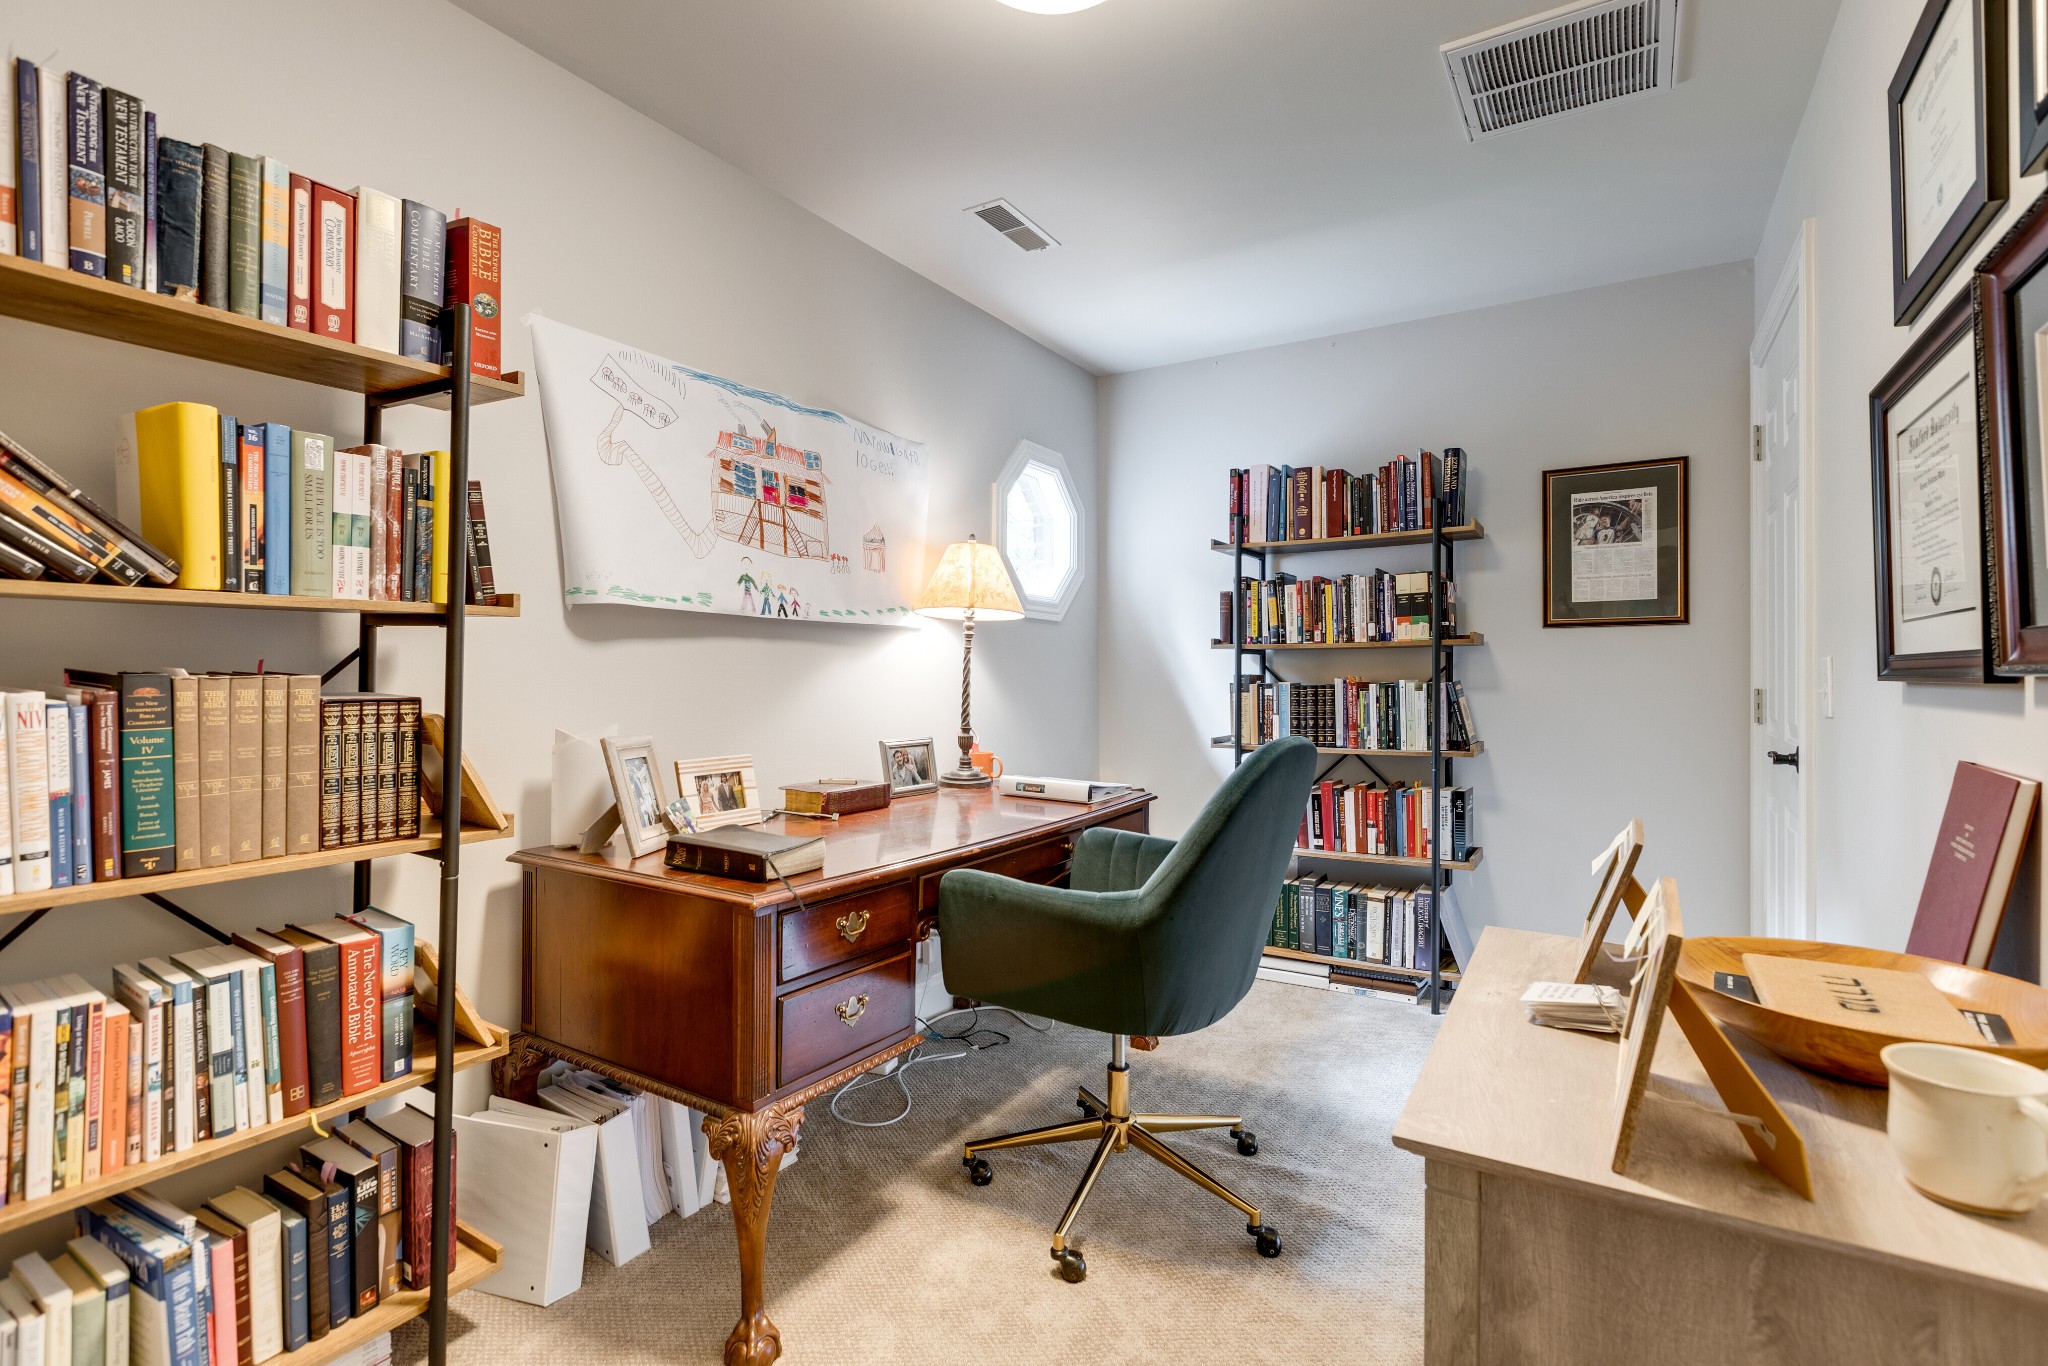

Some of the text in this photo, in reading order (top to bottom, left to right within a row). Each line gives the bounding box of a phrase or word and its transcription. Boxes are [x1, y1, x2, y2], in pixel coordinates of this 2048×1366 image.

[76, 77, 90, 165] NEW TESTAMENT
[115, 96, 128, 185] NEW TESTAMENT
[115, 224, 125, 243] MOO
[125, 219, 137, 248] CARSON
[325, 218, 336, 270] COMMENTARY
[410, 210, 422, 290] COMMENTARY
[83, 261, 94, 271] B
[423, 238, 432, 271] BIBLE
[478, 228, 492, 281] BIBLE
[247, 433, 258, 442] 16
[1444, 456, 1452, 493] NEHEMIAH
[1451, 475, 1459, 490] AND
[304, 473, 314, 540] SMALL FOR US
[316, 476, 325, 560] THE PLACE IS TOO
[17, 711, 43, 730] NIV
[74, 712, 84, 755] Philippians
[58, 714, 66, 779] COLOSSIANS
[129, 735, 165, 745] Volume
[141, 746, 154, 755] IV
[103, 769, 112, 790] JAMES
[363, 945, 376, 969] The
[391, 944, 399, 977] WORD
[400, 948, 408, 968] KEY
[348, 950, 361, 1045] Annotated Bible
[363, 970, 376, 997] New
[151, 1014, 159, 1056] MISSIONAL
[195, 999, 204, 1063] THE GREAT EMERGENCE
[363, 999, 377, 1041] Oxford
[92, 1026, 102, 1052] LIGHT
[89, 1075, 100, 1116] NATIONS
[357, 1180, 378, 1195] Life
[382, 1171, 390, 1212] BIBLE
[330, 1201, 349, 1214] Holy
[331, 1209, 349, 1222] Bible
